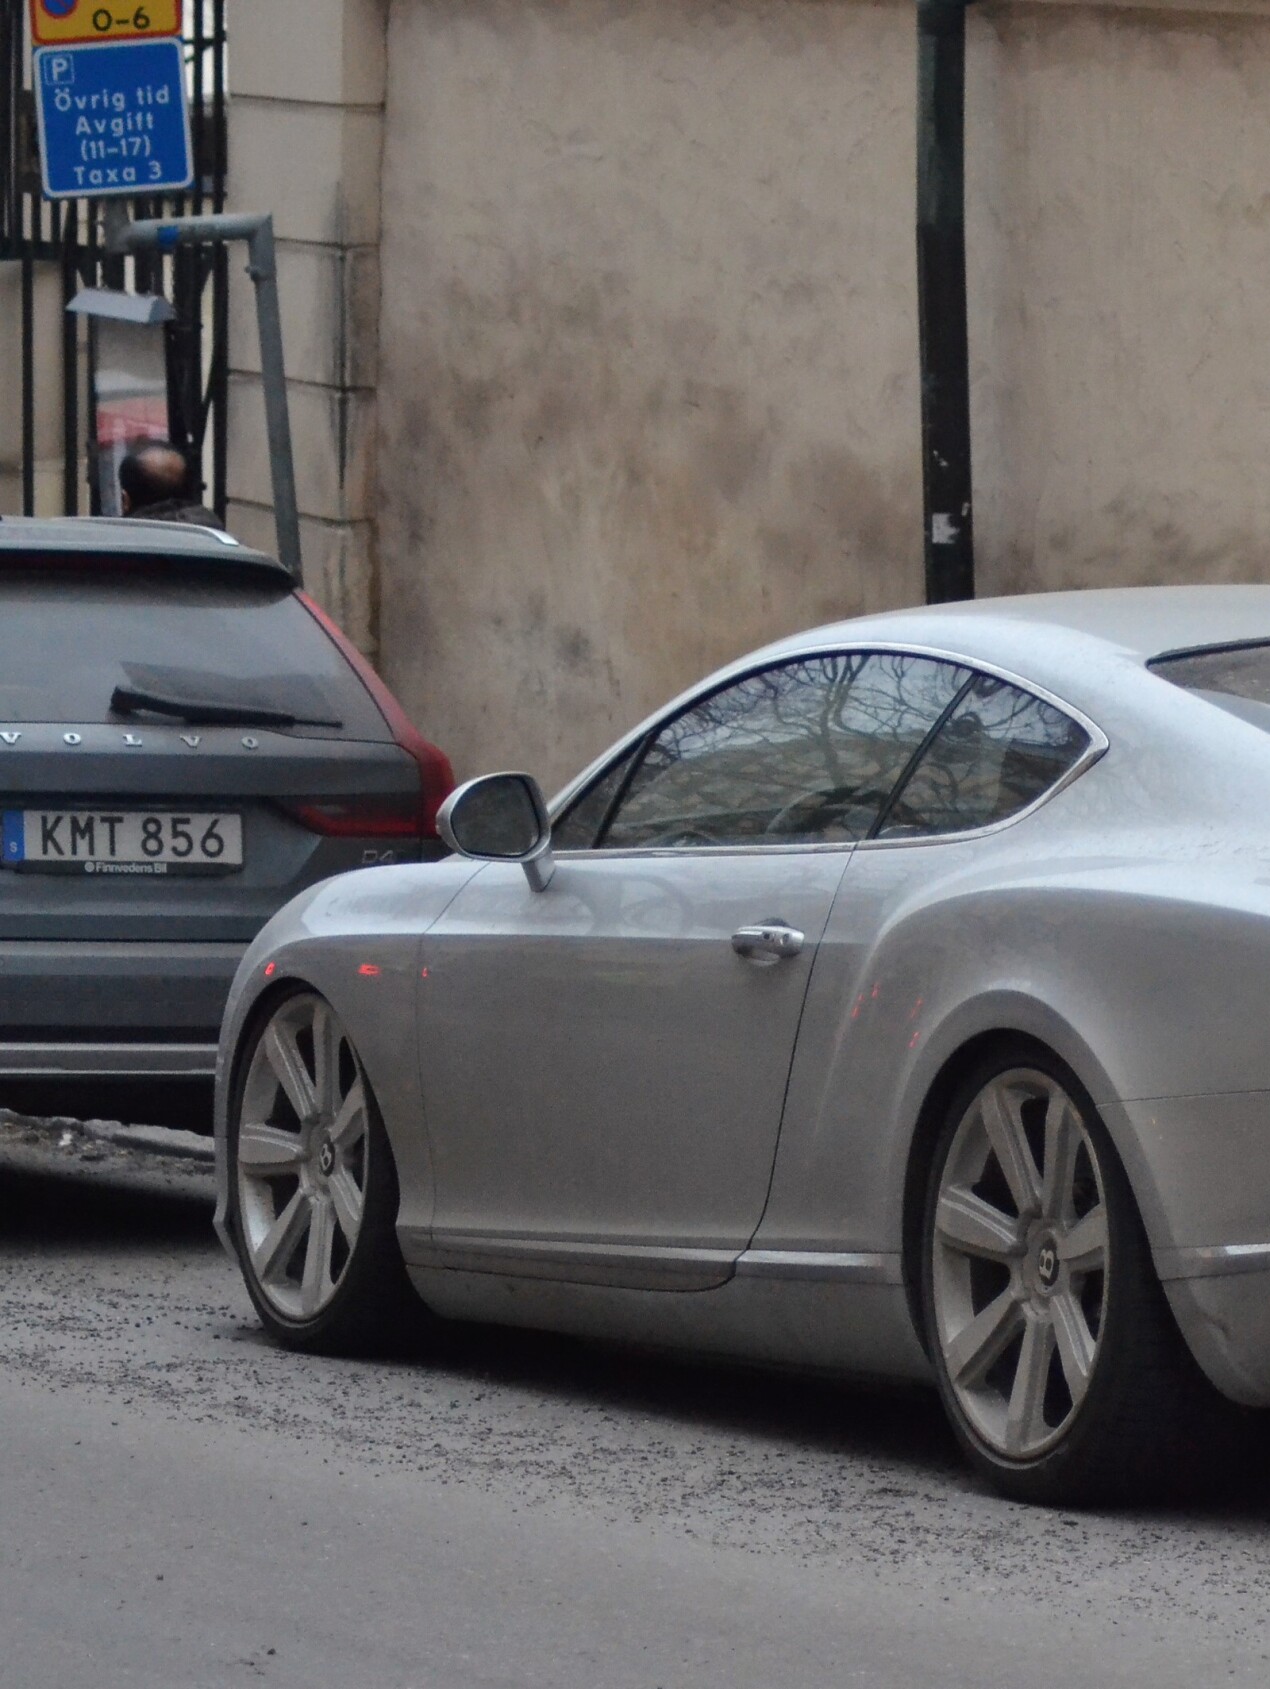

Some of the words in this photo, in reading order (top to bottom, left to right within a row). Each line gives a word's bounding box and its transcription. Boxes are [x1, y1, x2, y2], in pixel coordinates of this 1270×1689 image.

[92, 7, 150, 32] 0-6
[52, 57, 68, 81] P
[53, 88, 125, 112] Övrig
[137, 85, 169, 105] tid
[75, 112, 154, 137] Avgift
[80, 135, 151, 161] (11-17)
[74, 165, 136, 185] Taxa
[148, 160, 162, 180] 3
[0, 731, 259, 749] VOLVO
[10, 841, 17, 852] S
[40, 814, 124, 856] KMT
[140, 817, 225, 858] 856
